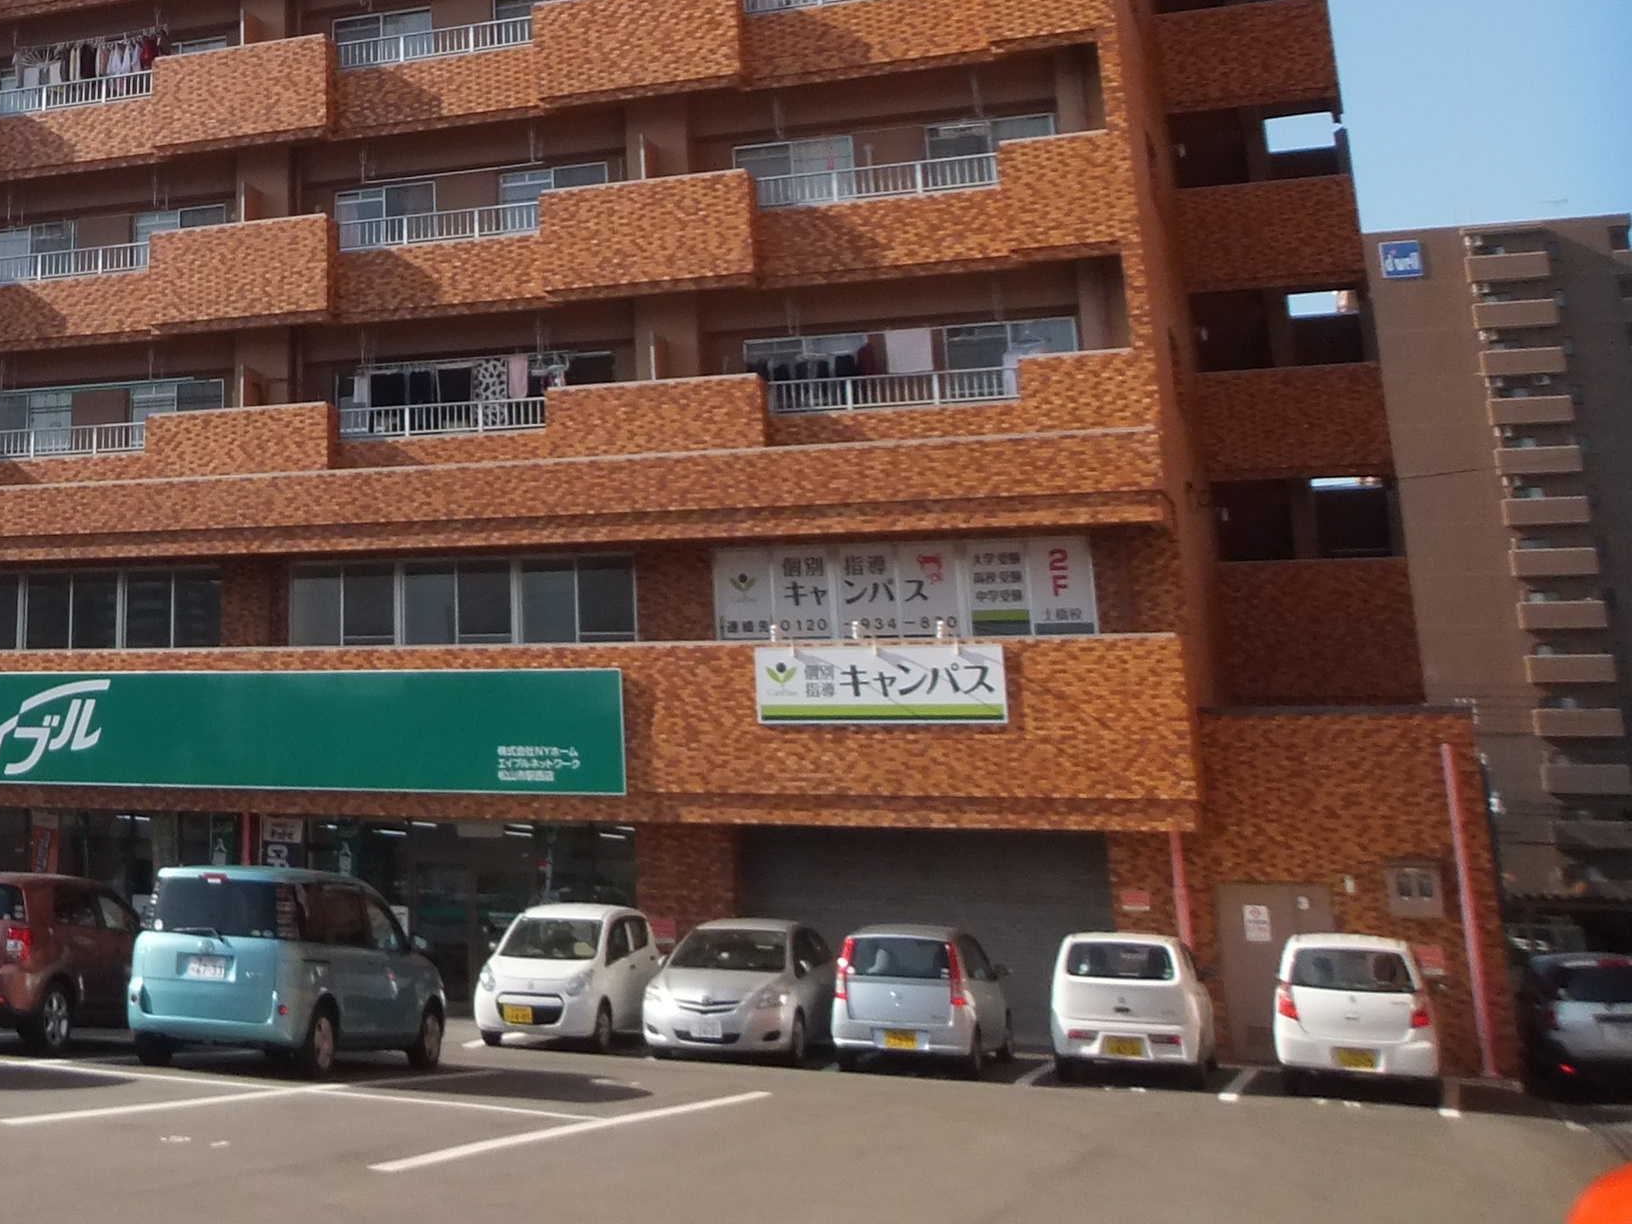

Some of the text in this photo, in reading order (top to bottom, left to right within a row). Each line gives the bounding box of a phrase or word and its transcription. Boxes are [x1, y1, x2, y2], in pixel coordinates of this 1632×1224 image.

[784, 578, 929, 606] キャンパス
[781, 615, 958, 632] 0120-934-80
[839, 662, 995, 697] キャンパス
